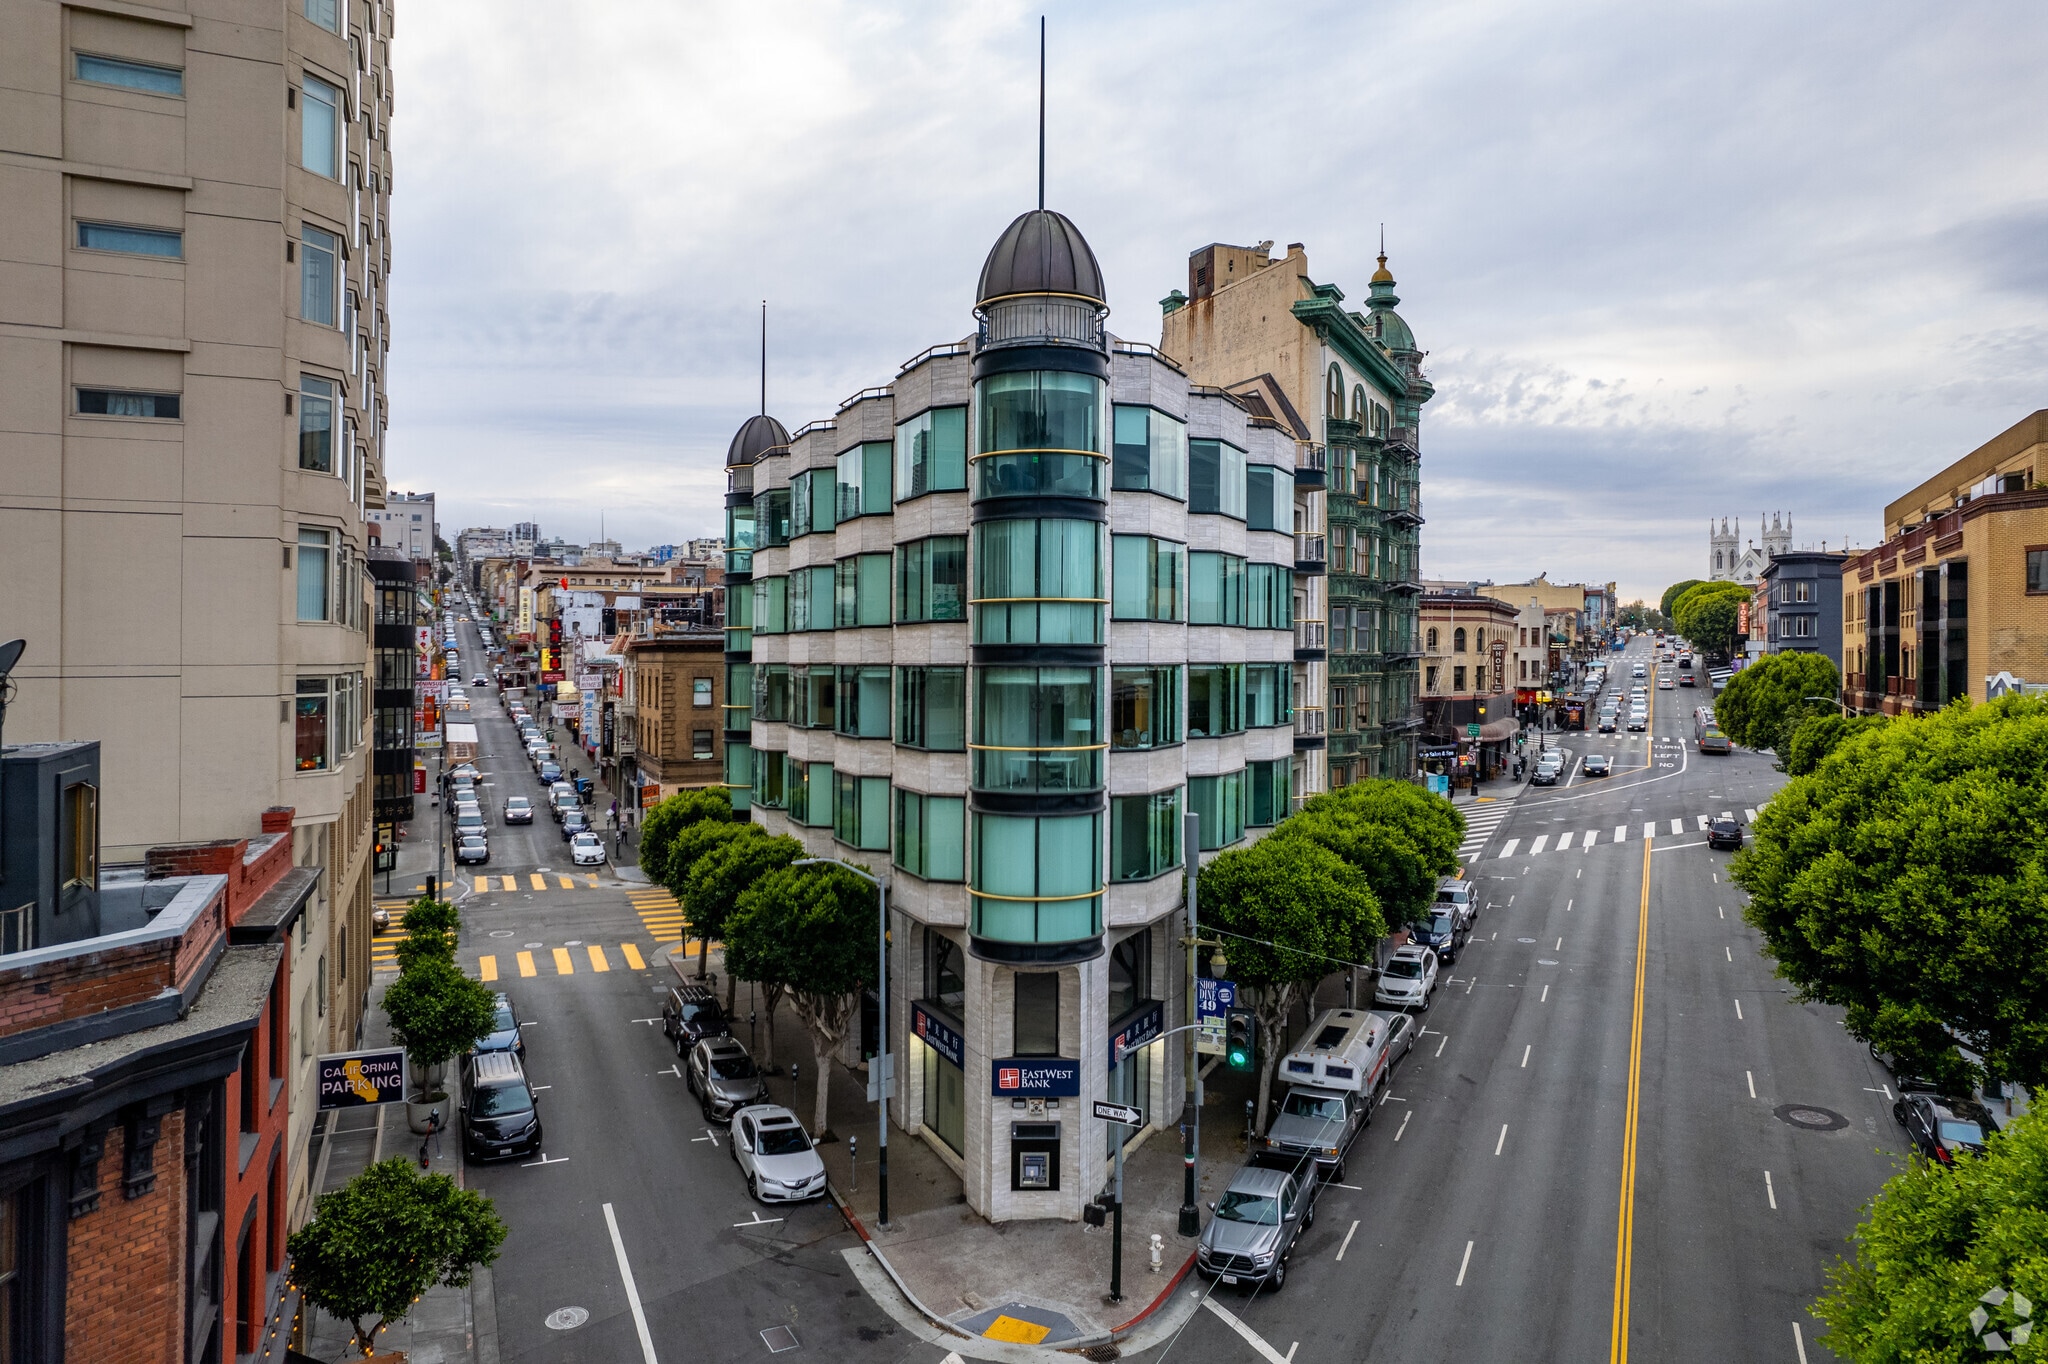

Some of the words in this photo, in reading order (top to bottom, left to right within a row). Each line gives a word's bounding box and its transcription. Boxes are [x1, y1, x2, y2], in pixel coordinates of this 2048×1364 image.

[1199, 979, 1217, 990] SHOP
[1199, 988, 1217, 1001] DINE
[1199, 1000, 1217, 1011] 49
[323, 1061, 399, 1078] CALIFORNIA
[322, 1074, 401, 1095] PARKING
[1021, 1079, 1051, 1088] BANK
[1097, 1106, 1111, 1115] ONE
[1113, 1110, 1127, 1118] WAY
